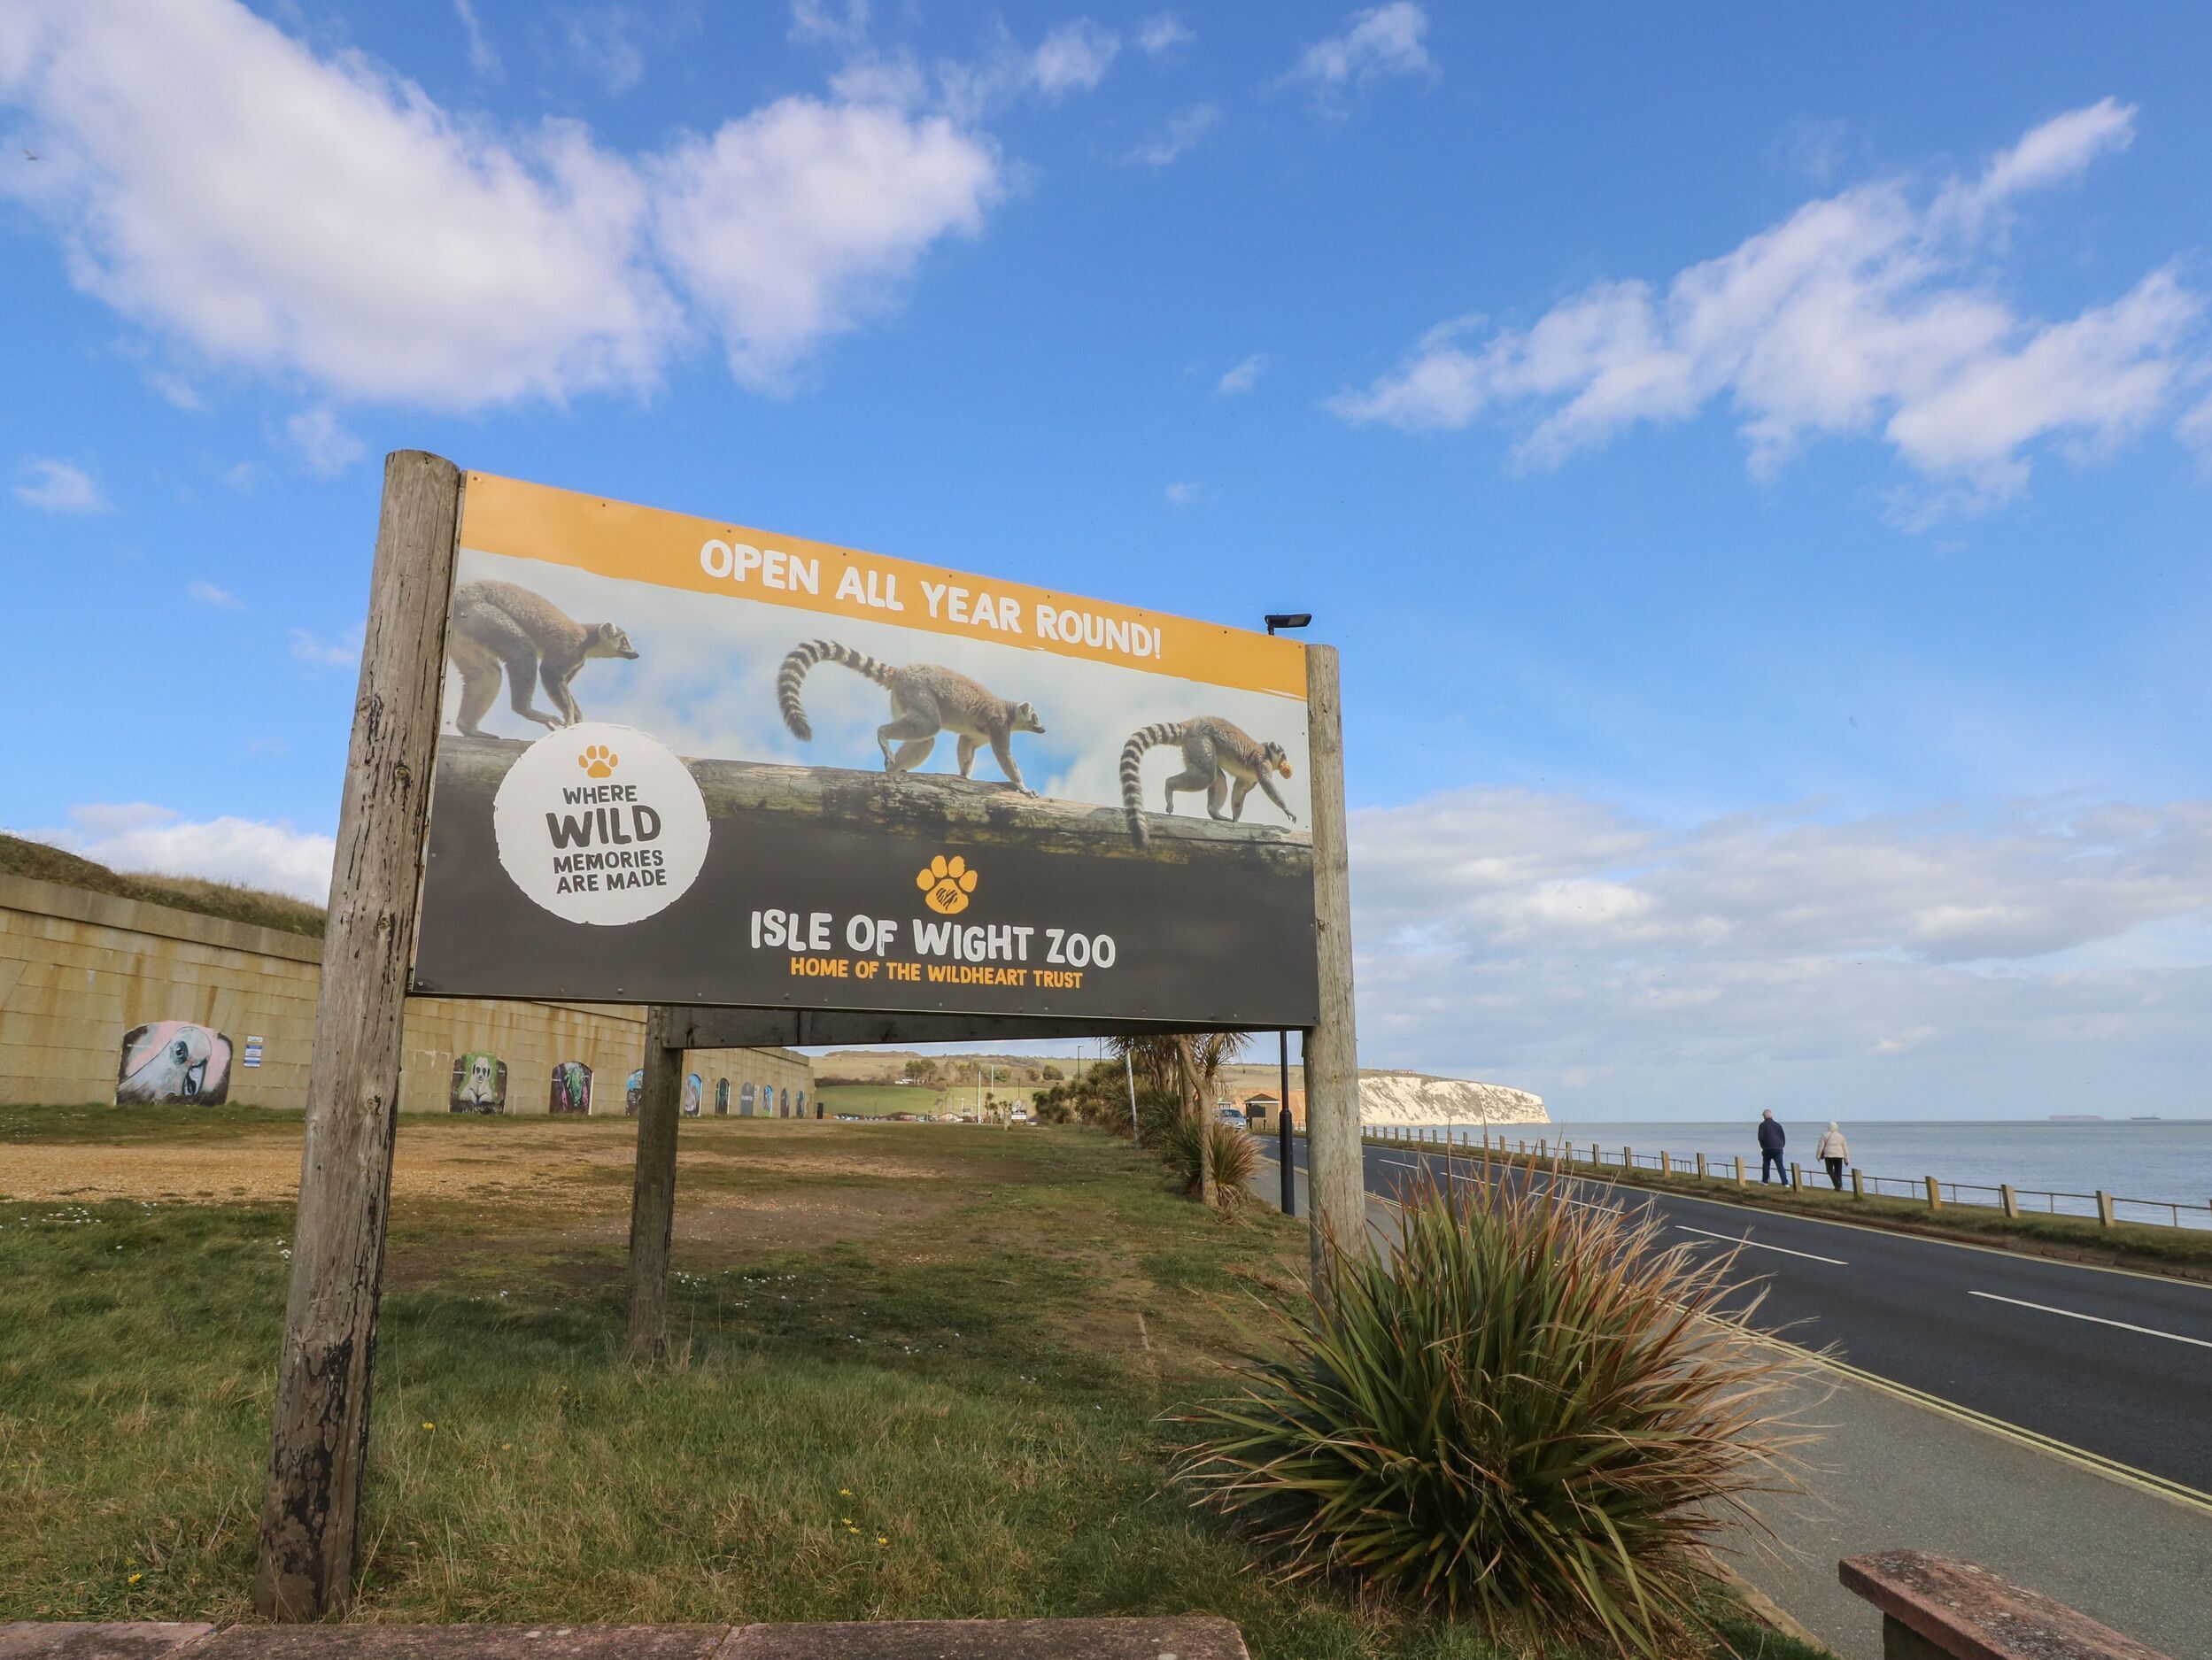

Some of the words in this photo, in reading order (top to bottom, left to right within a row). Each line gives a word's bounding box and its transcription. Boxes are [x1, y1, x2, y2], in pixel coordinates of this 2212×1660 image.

[700, 539, 819, 595] OPEN
[835, 566, 904, 611] ALL
[920, 581, 1022, 633] YEAR
[1036, 604, 1161, 659] ROUND!
[562, 784, 638, 805] WHERE
[545, 805, 661, 849] WILD
[553, 849, 663, 874] MEMORIES
[556, 874, 599, 894] ARE
[606, 869, 668, 892] MADE
[751, 909, 832, 952] ISLE
[846, 915, 898, 957] OF
[912, 918, 1034, 962] WIGHT
[1045, 929, 1116, 969] ZOO
[791, 957, 849, 977] HOME
[855, 961, 879, 979] OF
[886, 962, 922, 982] THE
[927, 964, 1027, 986] WILDHEART
[1033, 969, 1084, 989] TRUST
